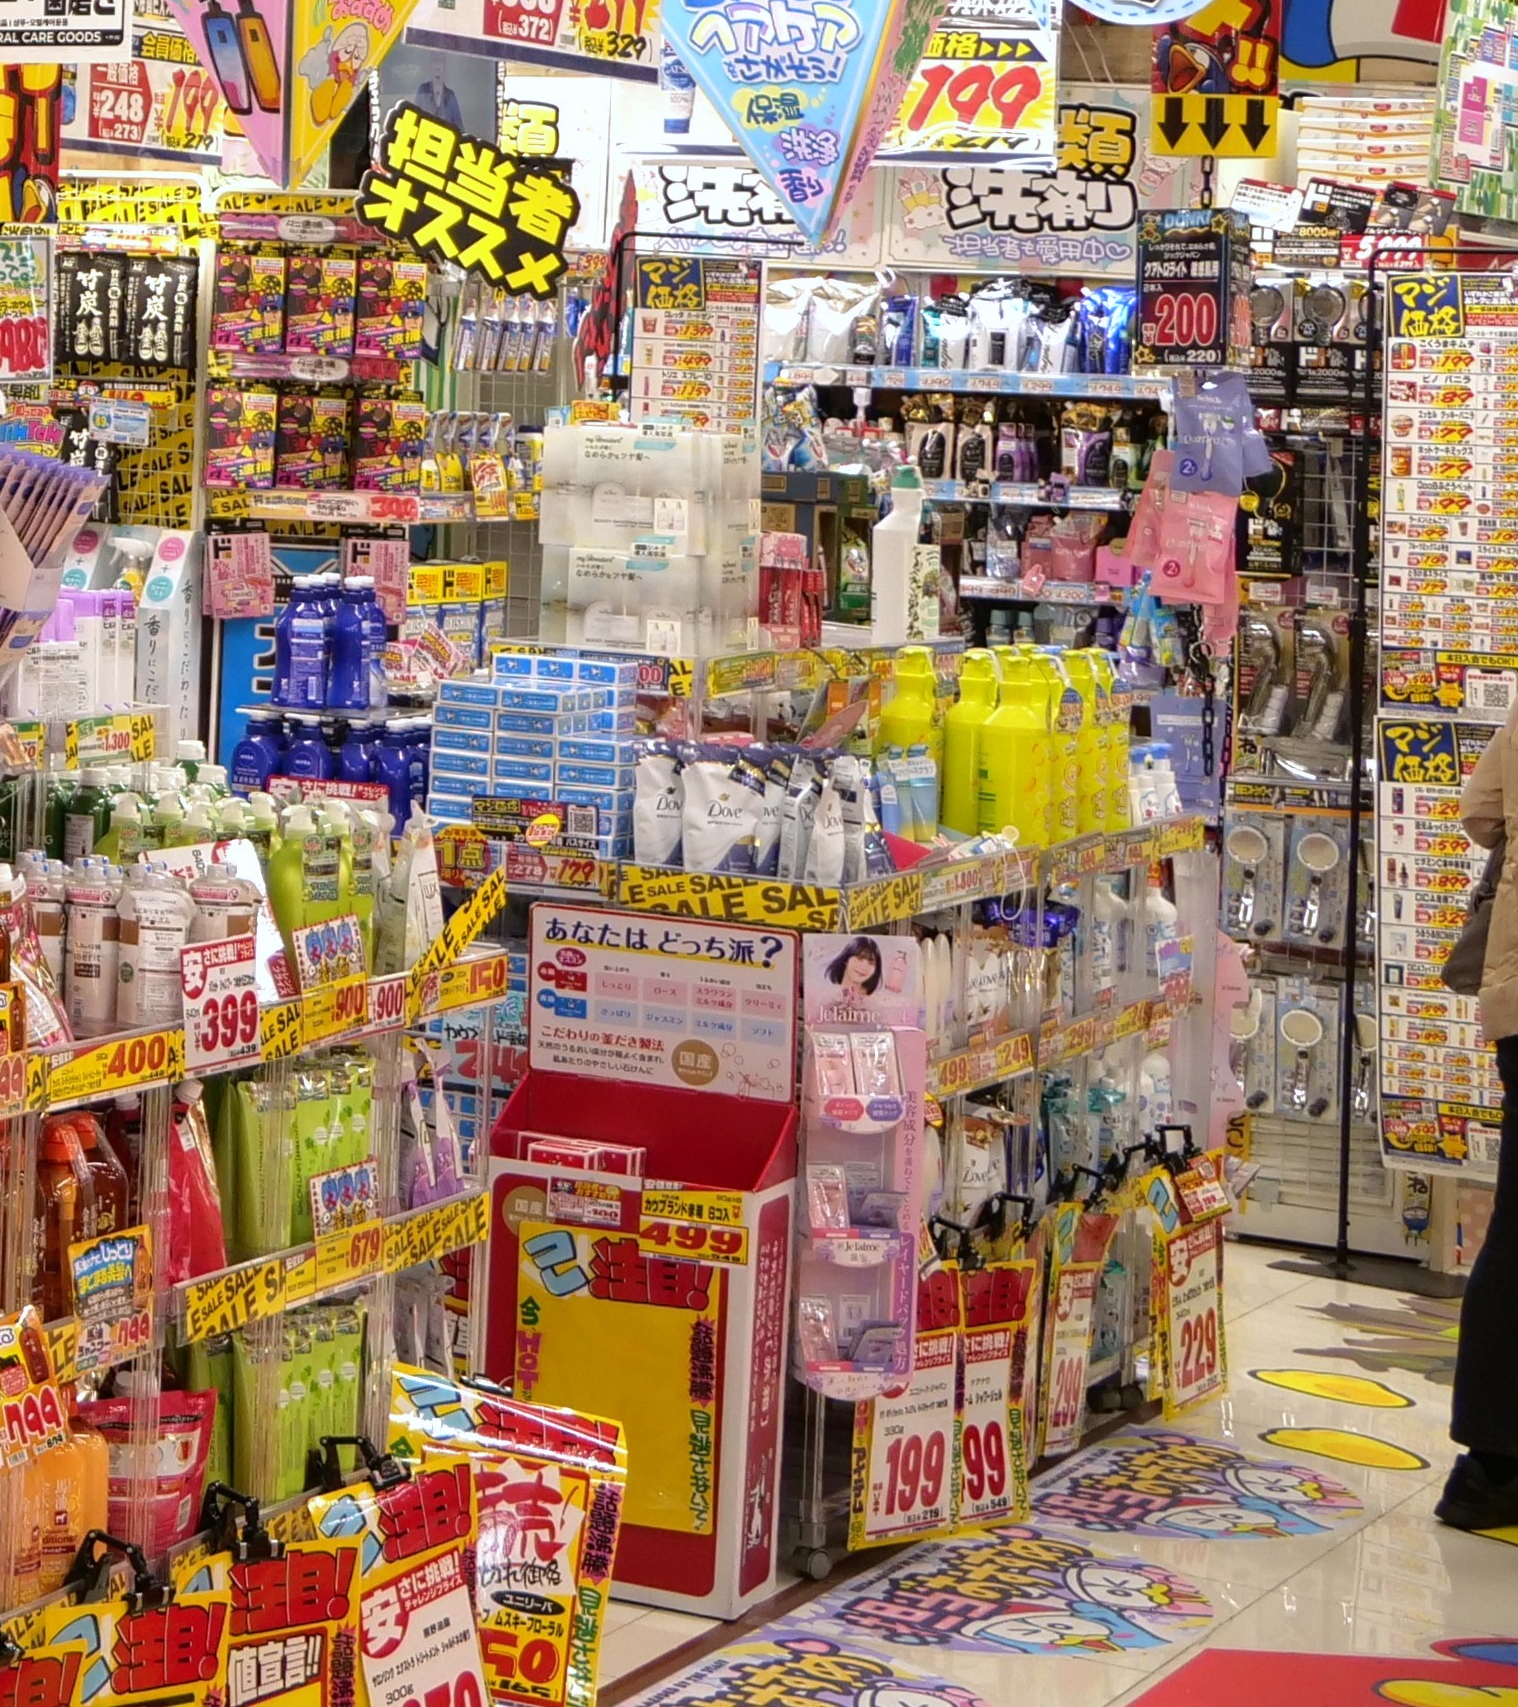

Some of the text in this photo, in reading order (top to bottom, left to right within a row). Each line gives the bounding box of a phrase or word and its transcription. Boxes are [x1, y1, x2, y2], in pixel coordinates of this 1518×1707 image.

[24, 31, 55, 44] CARE
[59, 30, 101, 44] GOODS
[365, 176, 560, 296] オススメ
[707, 799, 746, 822] Dove
[546, 917, 649, 950] あなたは
